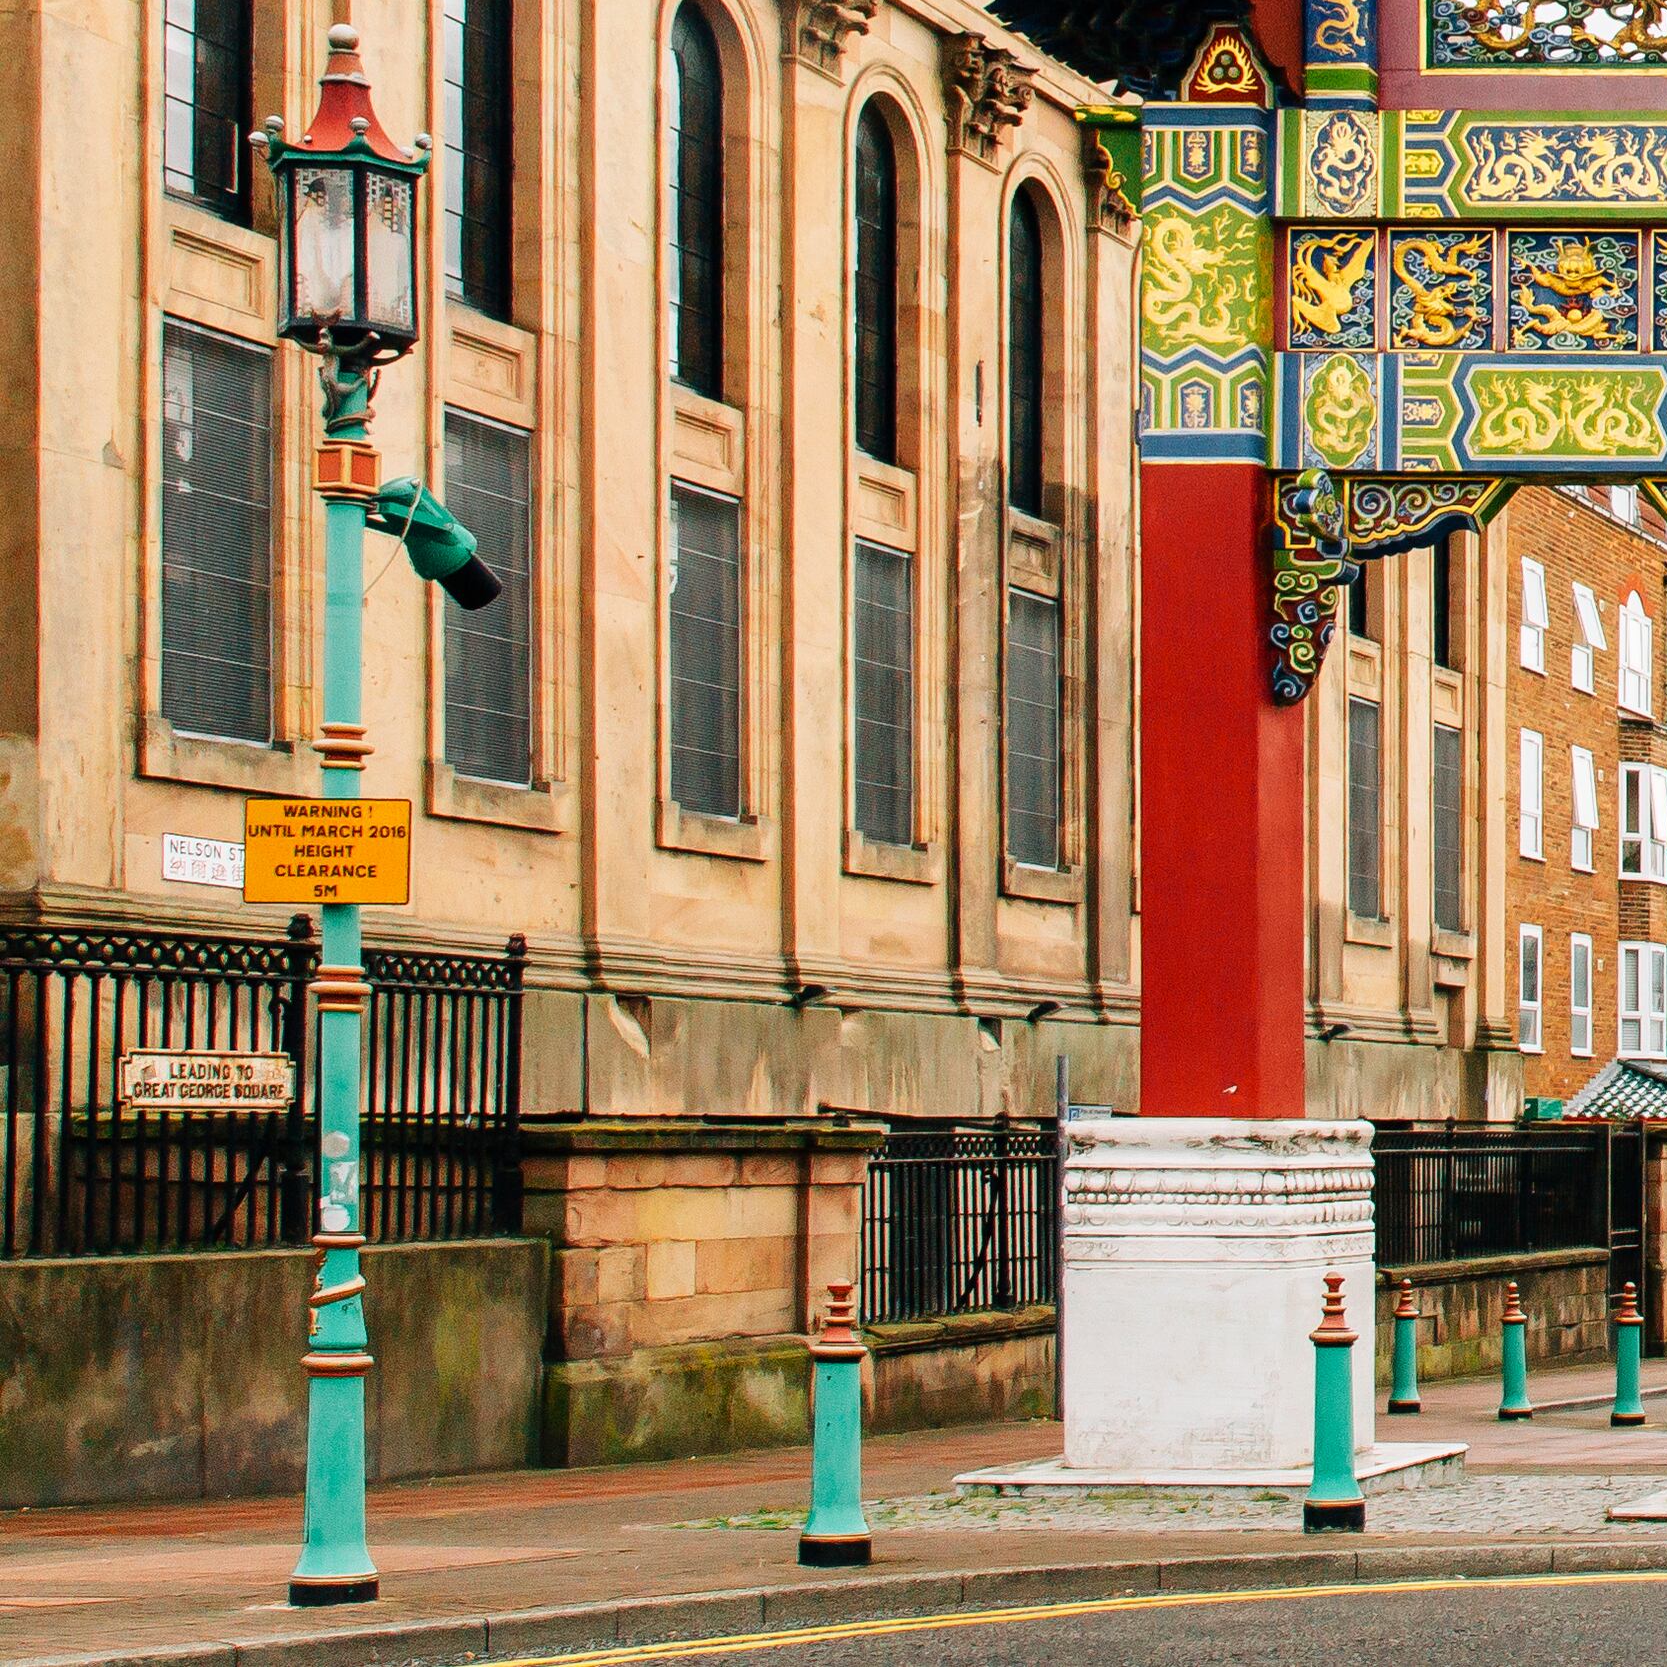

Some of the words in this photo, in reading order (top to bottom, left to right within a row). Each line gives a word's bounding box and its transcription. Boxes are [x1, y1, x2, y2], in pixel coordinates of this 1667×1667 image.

[284, 805, 362, 818] WARNING
[248, 825, 295, 837] UNTIL
[302, 825, 363, 838] MARCH
[369, 825, 407, 838] 2016
[170, 839, 222, 859] NELSON
[294, 845, 355, 858] HEIGHT
[274, 865, 378, 878] CLEARANCE
[314, 885, 338, 897] 5M
[170, 1062, 232, 1080] LEADING
[236, 1064, 254, 1080] TO
[133, 1082, 176, 1098] GREAT
[180, 1083, 231, 1099] GEORGE
[235, 1083, 286, 1099] SQUARE
